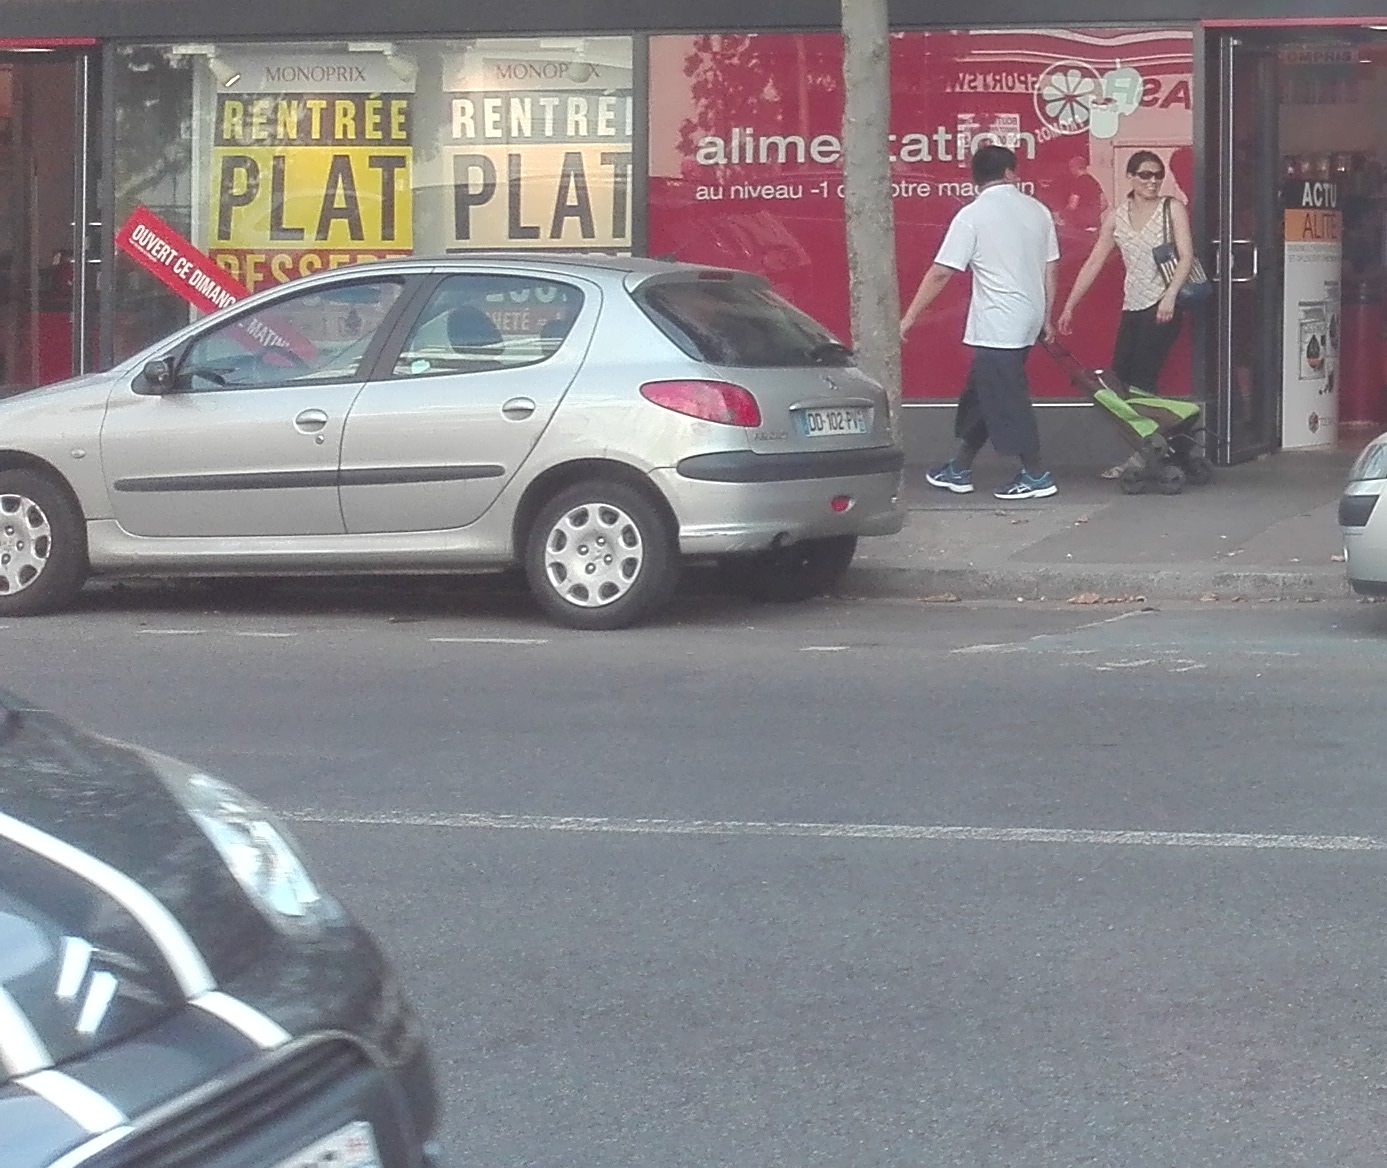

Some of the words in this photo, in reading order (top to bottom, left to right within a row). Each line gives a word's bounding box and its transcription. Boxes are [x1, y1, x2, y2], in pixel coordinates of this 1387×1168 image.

[265, 66, 366, 83] MONOPRIX
[495, 62, 600, 81] MONOPX
[222, 91, 408, 140] RENTRÉE
[451, 87, 632, 139] RENTRÉ
[215, 154, 407, 242] PLAT
[695, 185, 723, 200] au
[730, 182, 803, 199] niveau
[891, 180, 931, 198] otre
[1302, 182, 1338, 208] ACTU
[131, 224, 178, 266] OUVERT
[173, 257, 189, 279] CE
[188, 270, 238, 310] DIMANC
